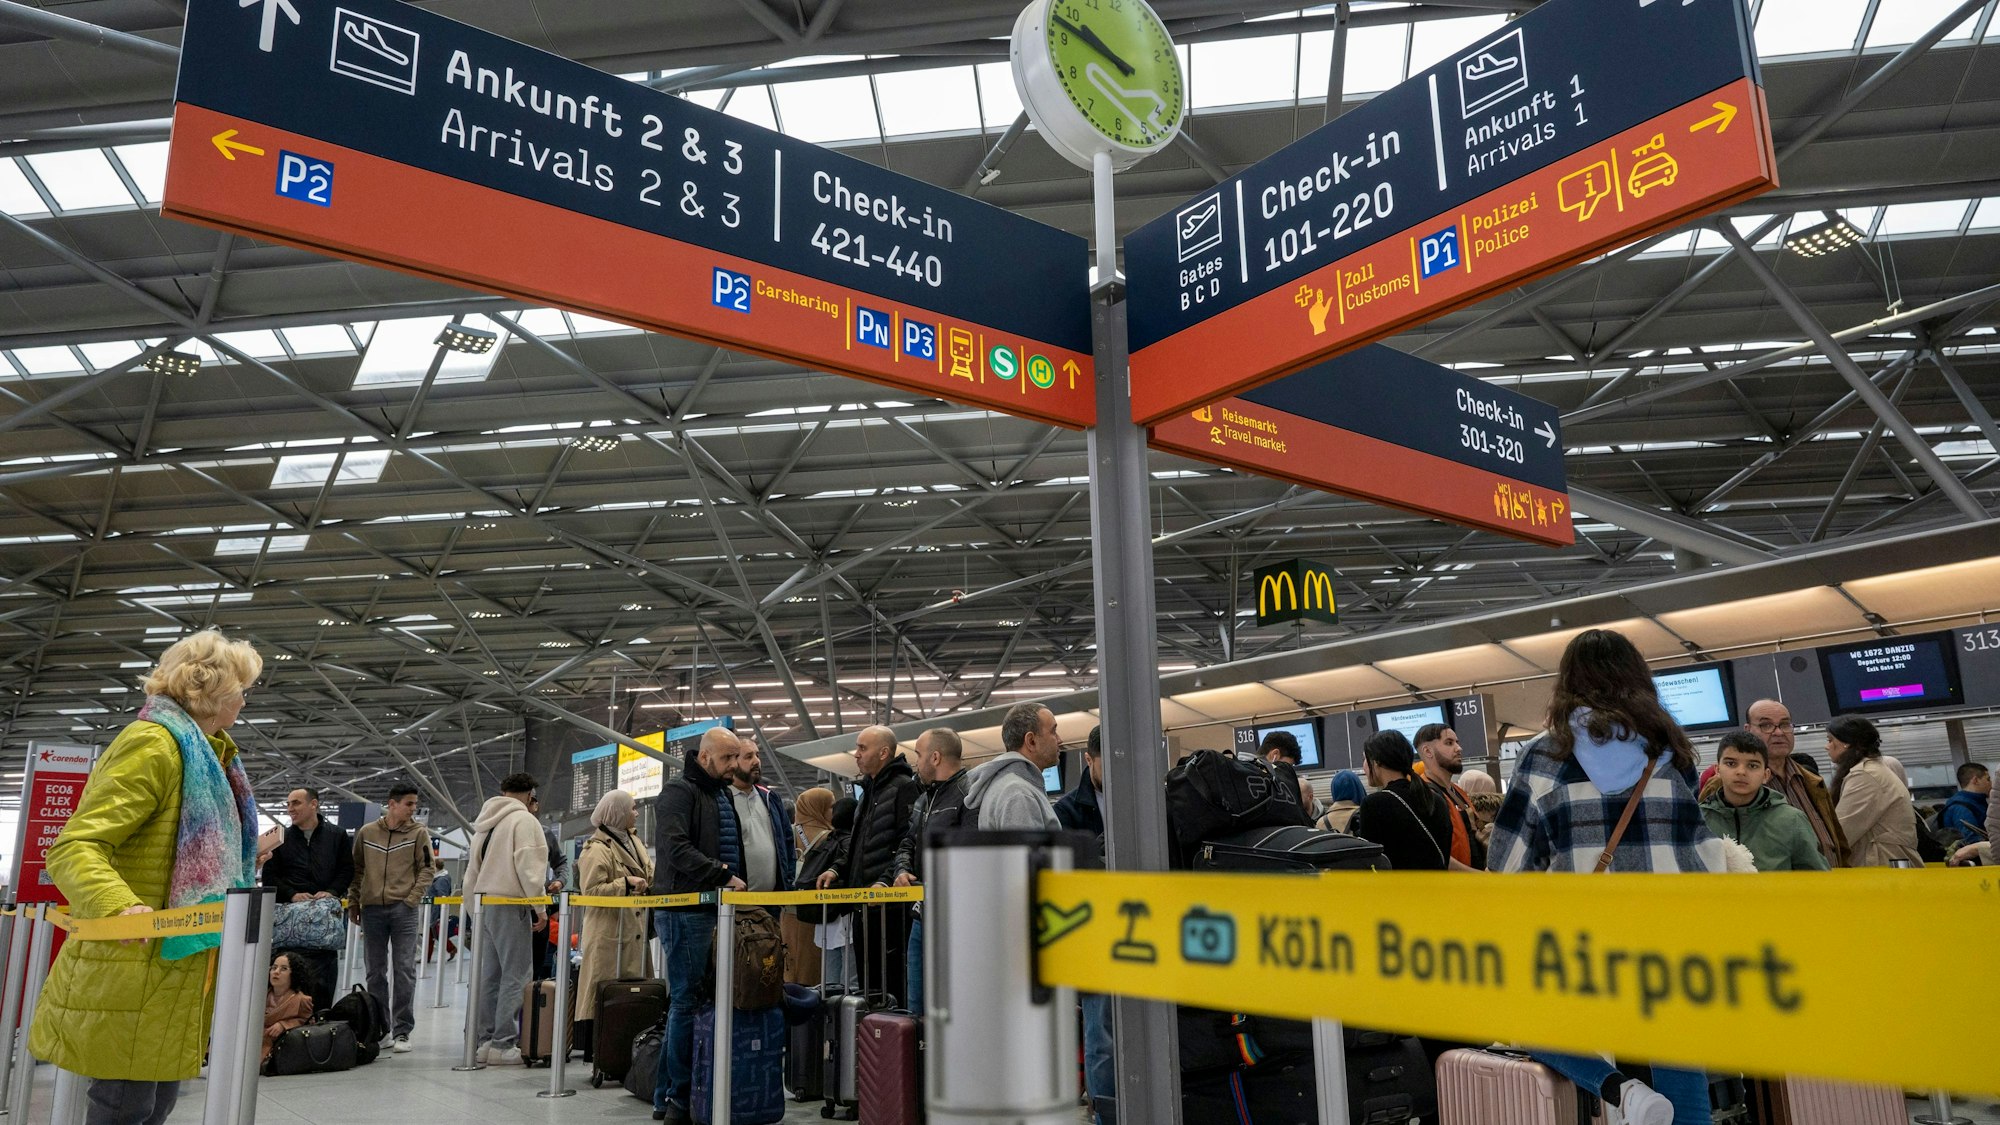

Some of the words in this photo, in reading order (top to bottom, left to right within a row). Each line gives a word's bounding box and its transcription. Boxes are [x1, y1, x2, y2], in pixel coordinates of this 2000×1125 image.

[1066, 6, 1080, 22] 10
[1061, 32, 1068, 46] 9
[1154, 50, 1161, 63] 2
[1070, 66, 1077, 79] 8
[1162, 80, 1169, 93] 3
[446, 49, 623, 138] Ankunft
[641, 114, 663, 151] 2
[681, 127, 707, 165] &
[723, 139, 743, 175] 3
[1087, 98, 1094, 111] 7
[1154, 105, 1161, 116] 4
[1464, 90, 1557, 150] Ankunft
[1569, 74, 1585, 99] 1
[1115, 118, 1122, 131] 6
[1140, 121, 1147, 135] 5
[1468, 120, 1556, 177] Arrivals
[1575, 102, 1589, 127] 1
[441, 108, 614, 192] Arrivals
[640, 168, 661, 207] 2
[680, 180, 705, 219] &
[720, 192, 741, 228] 3
[1261, 129, 1401, 219] Check-in
[813, 171, 953, 243] Check-in
[1472, 191, 1539, 235] Polizei
[1264, 182, 1394, 272] 101-220
[1475, 224, 1529, 258] Police
[811, 222, 942, 288] 421-440
[1179, 256, 1223, 288] Gates
[1344, 263, 1375, 289] Zoll
[756, 280, 839, 319] Carsharing
[1181, 292, 1190, 311] B
[1195, 284, 1205, 304] C
[1210, 278, 1220, 297] D
[1346, 274, 1411, 310] Customs
[1222, 407, 1278, 435] Reisemarkt
[1456, 388, 1524, 431] Check-in
[1223, 424, 1252, 444] Travel
[1254, 436, 1287, 453] market
[1460, 424, 1524, 464] 301-320
[1498, 482, 1509, 495] WC
[1519, 492, 1530, 504] WC
[1850, 651, 1862, 659] W6
[1864, 648, 1883, 657] 1672
[1885, 644, 1915, 655] DANZIG
[1962, 629, 2000, 651] 313
[1857, 657, 1890, 666] Departure
[1892, 654, 1911, 663] 12:00
[1455, 700, 1477, 717] 315
[1237, 730, 1255, 744] 316
[52, 754, 89, 764] corendon
[45, 785, 74, 795] ECO&
[45, 797, 71, 806] FLEX
[40, 808, 73, 817] CLASS
[1258, 914, 1354, 974] Köln
[1377, 921, 1504, 987] Bonn
[1533, 927, 1803, 1017] Airport
